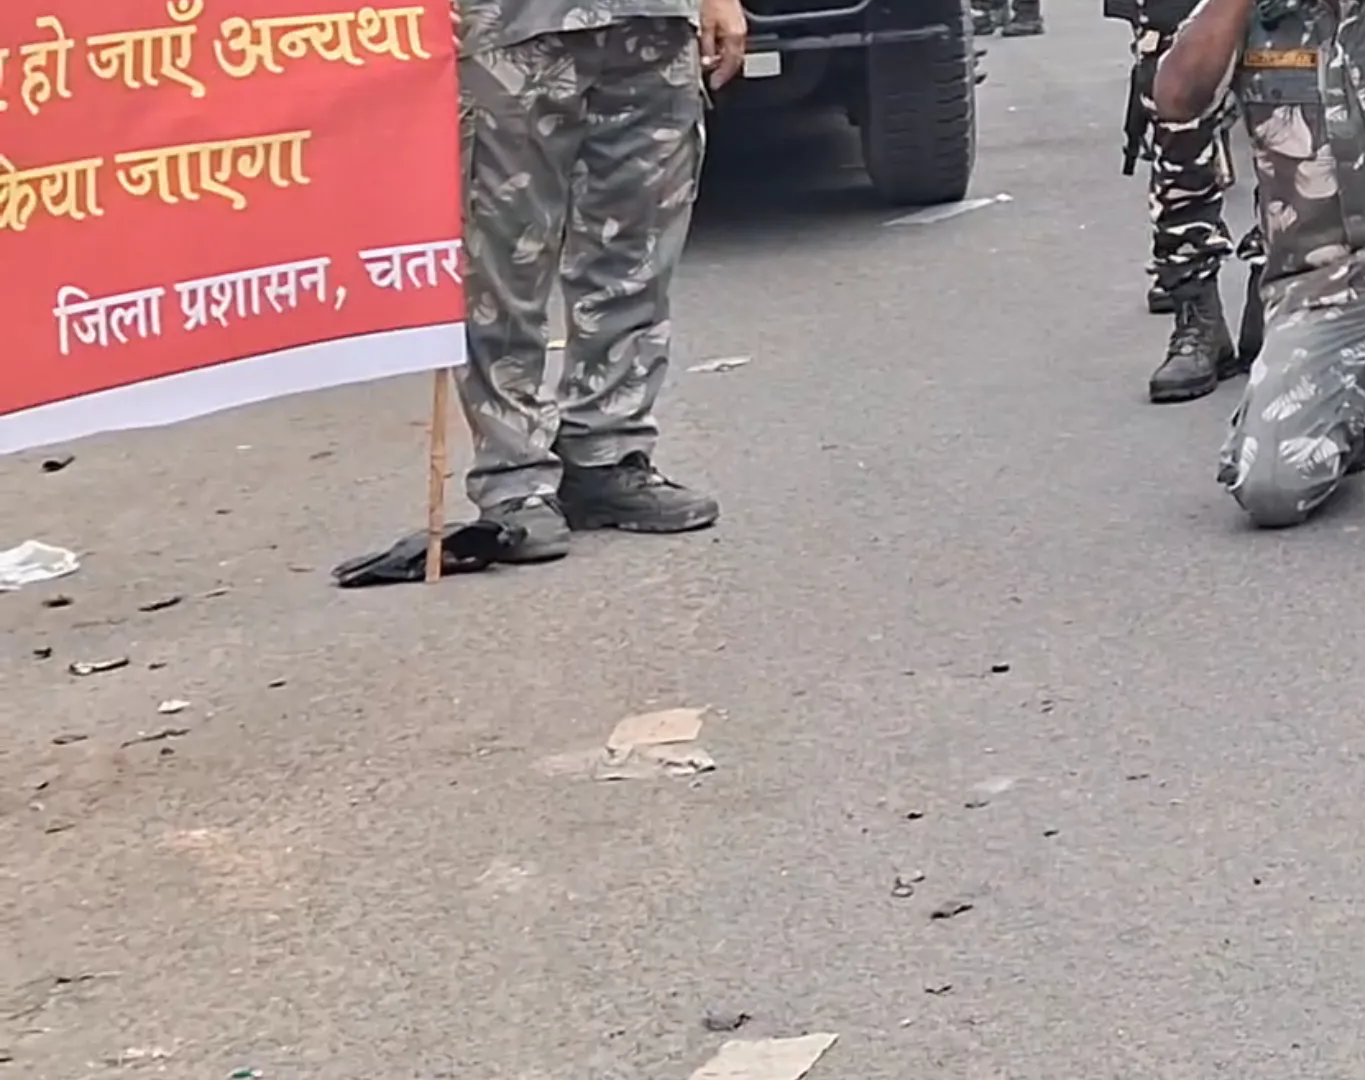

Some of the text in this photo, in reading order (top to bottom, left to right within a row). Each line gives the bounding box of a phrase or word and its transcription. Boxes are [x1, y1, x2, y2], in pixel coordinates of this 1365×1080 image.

[19, 16, 75, 116] हो
[213, 6, 431, 79] अन्यथा
[0, 129, 312, 232] कया जाएगा
[53, 285, 165, 356] जिला
[359, 238, 464, 293] चतर
